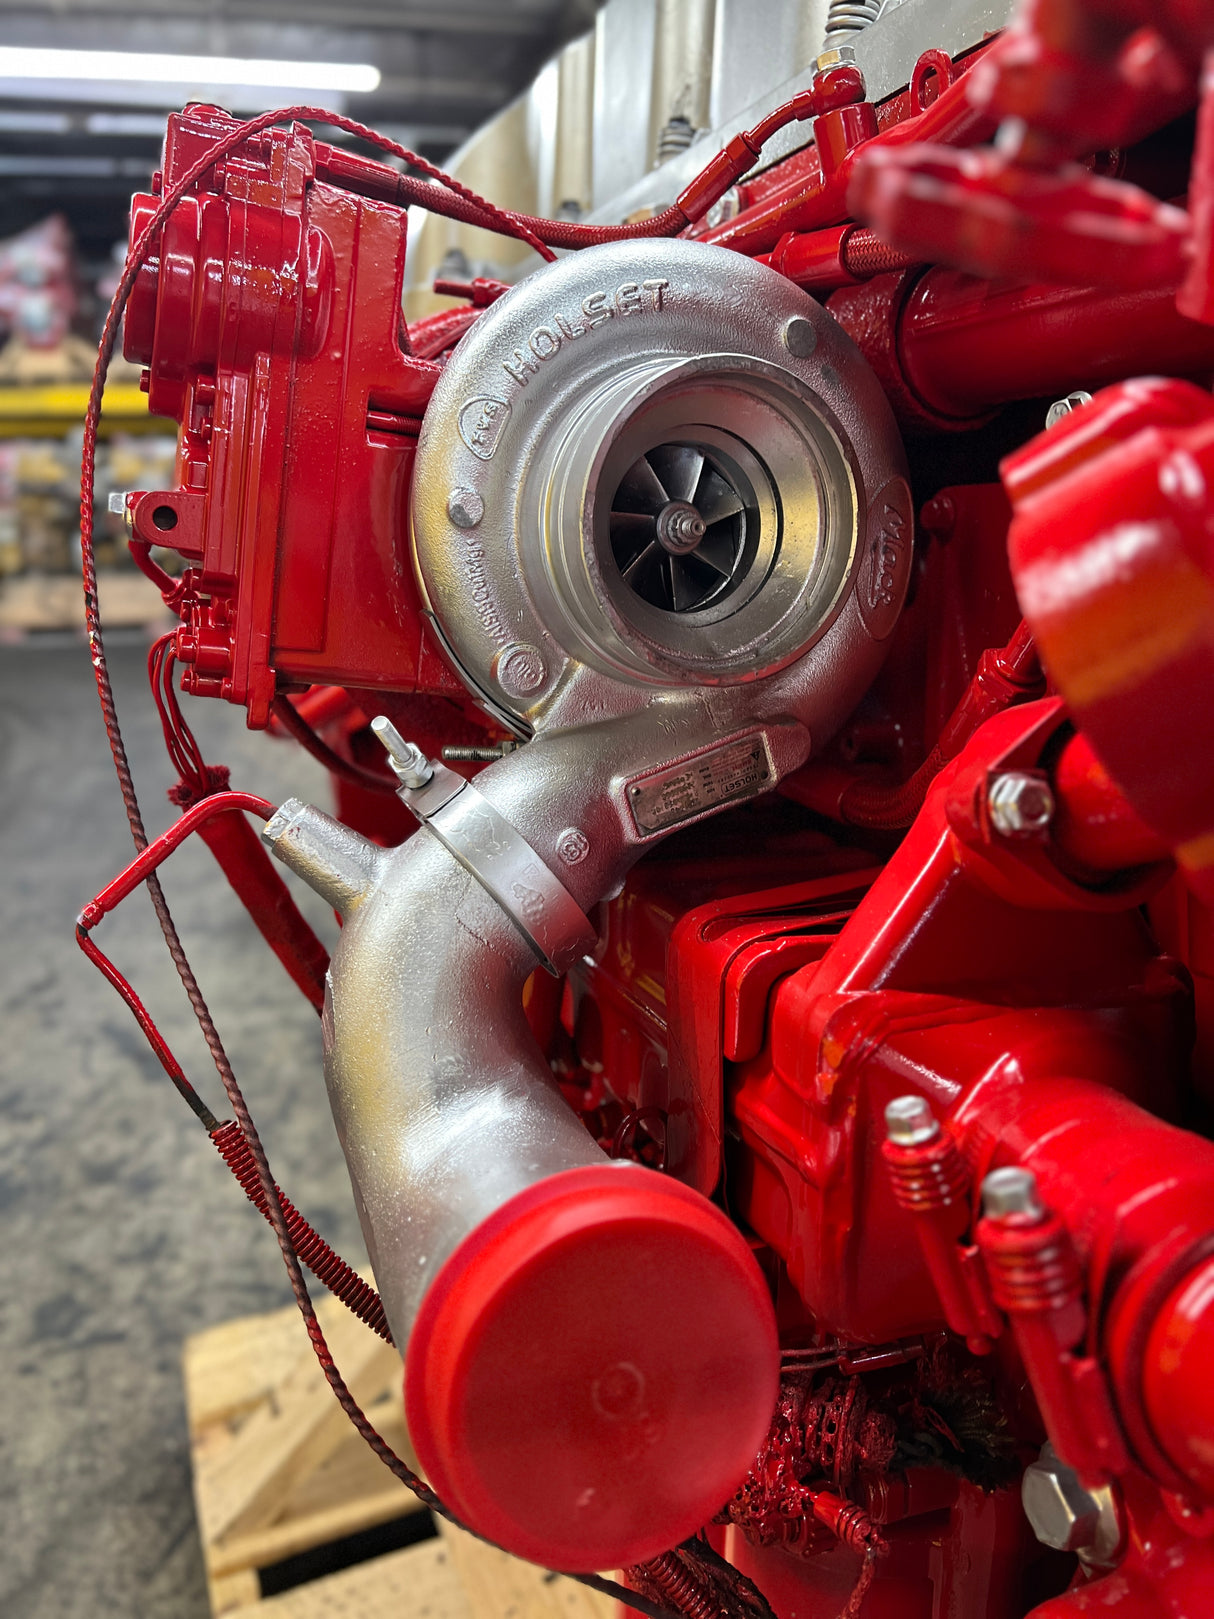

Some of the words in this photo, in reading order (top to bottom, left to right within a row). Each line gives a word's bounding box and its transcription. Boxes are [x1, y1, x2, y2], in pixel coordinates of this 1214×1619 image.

[501, 278, 669, 387] HOLSET
[871, 504, 905, 607] Mack
[724, 773, 758, 793] HOLSET
